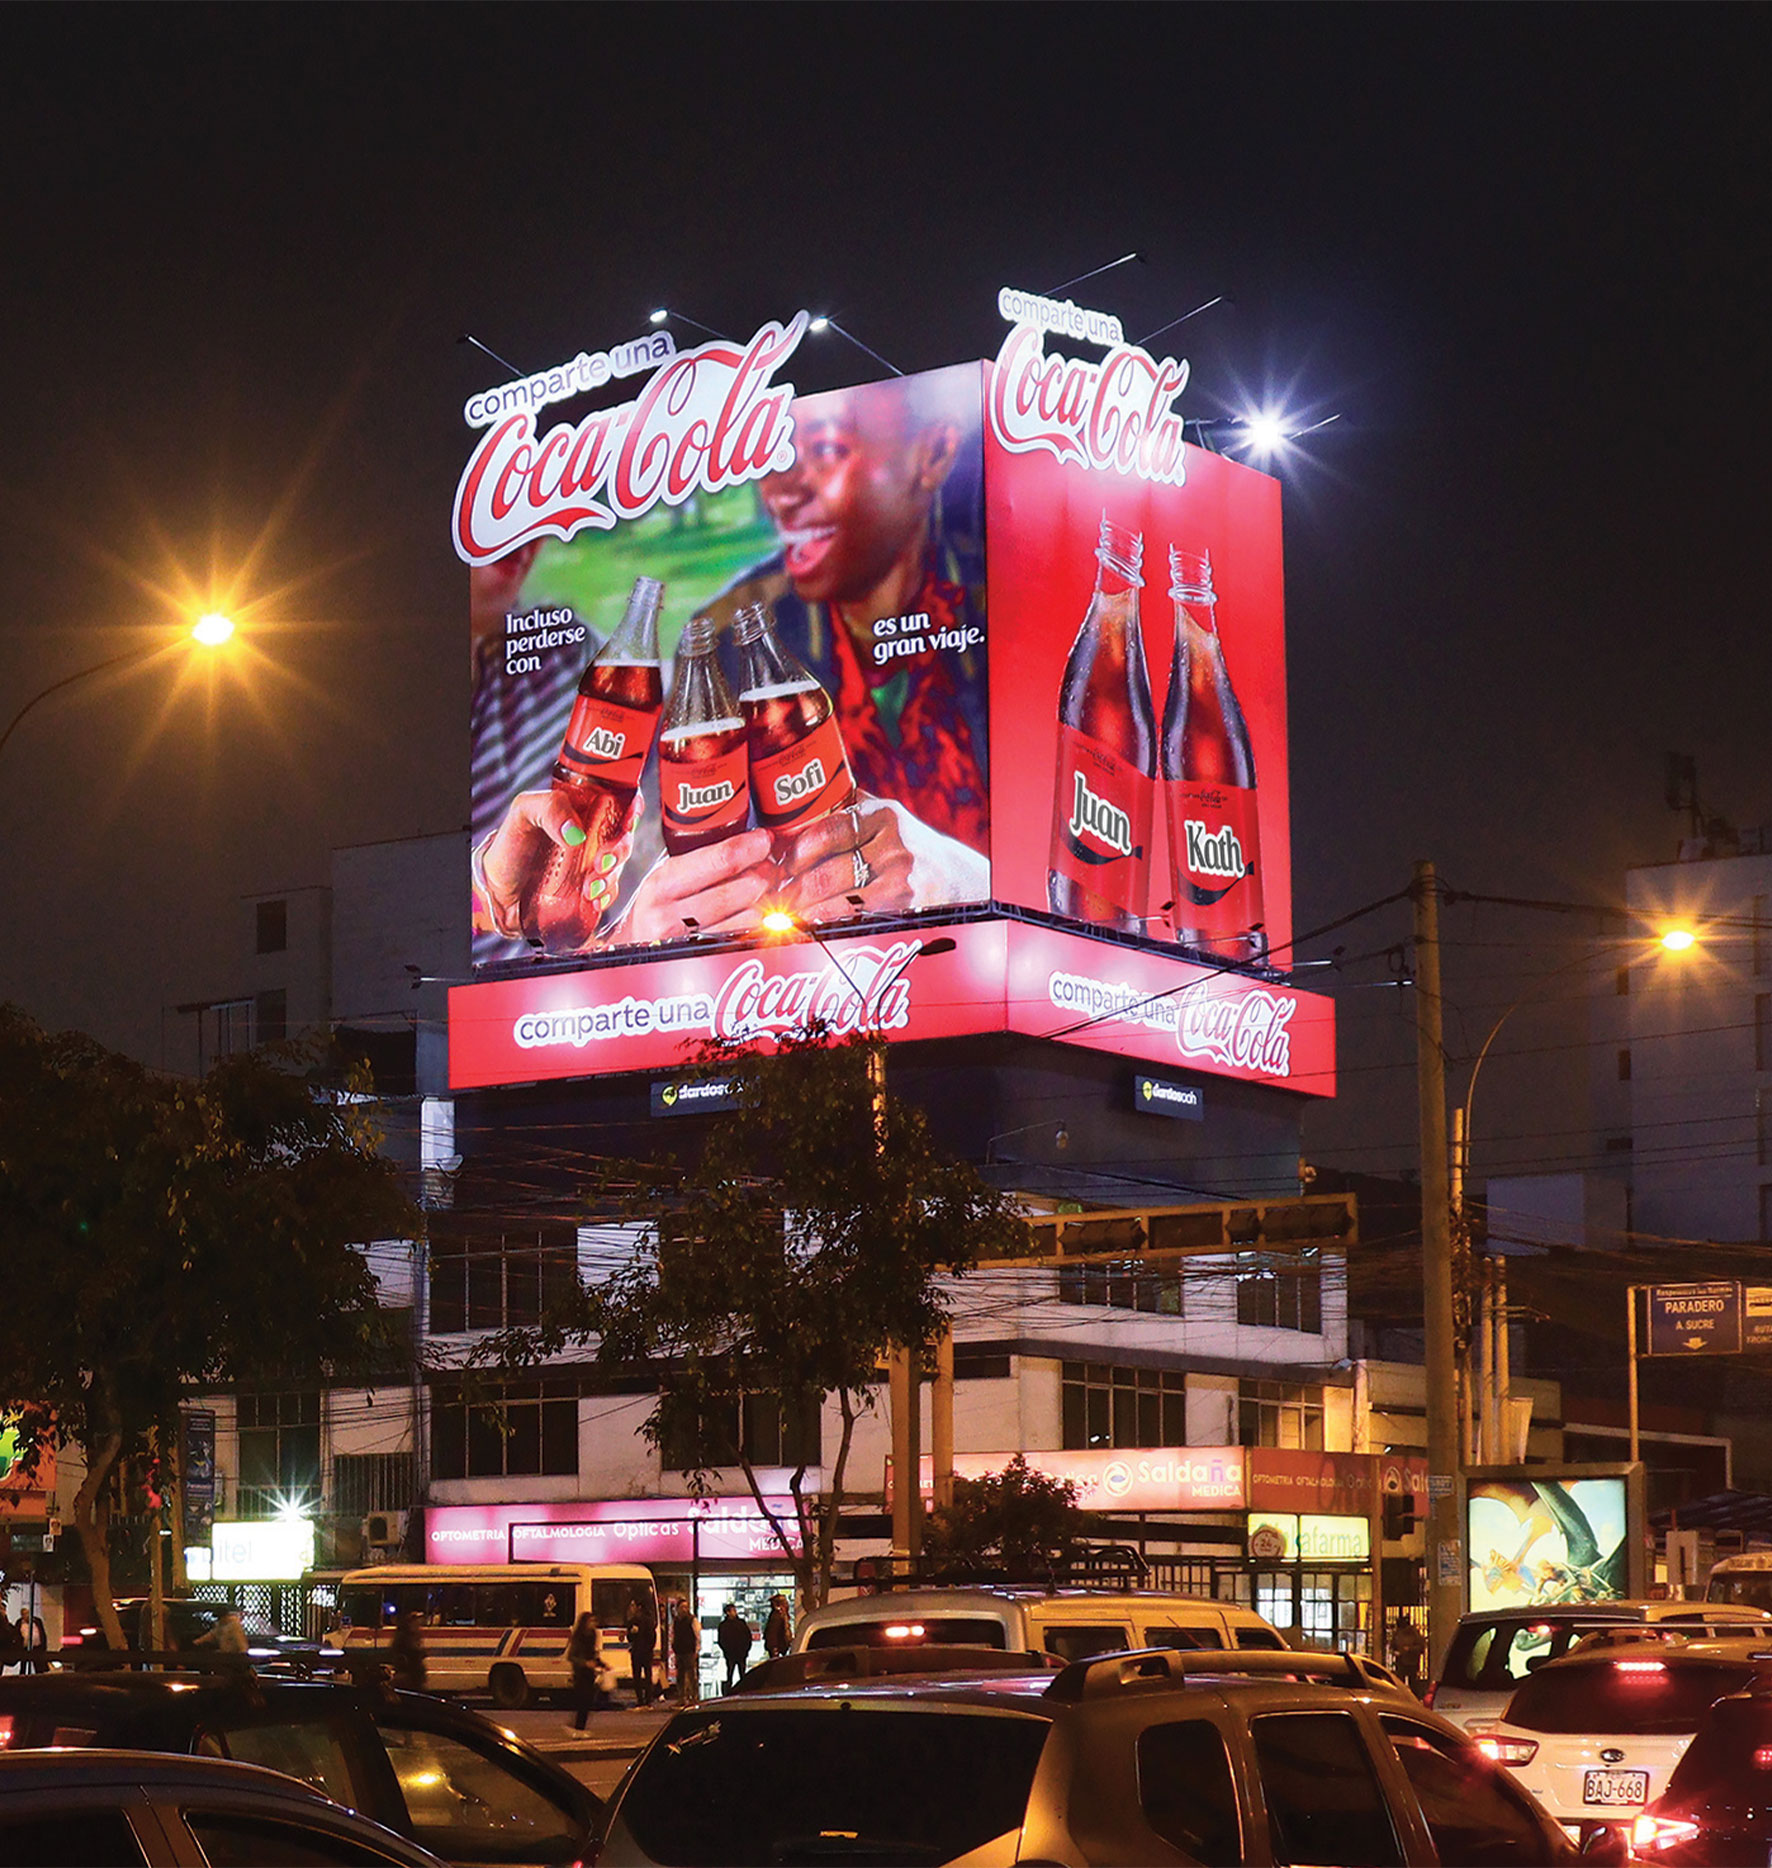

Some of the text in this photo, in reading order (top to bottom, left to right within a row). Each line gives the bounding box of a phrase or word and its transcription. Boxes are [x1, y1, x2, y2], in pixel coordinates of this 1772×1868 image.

[1001, 293, 1121, 342] comparte una
[467, 335, 671, 421] comparte una
[505, 607, 573, 634] Incluso
[873, 612, 931, 637] es un
[505, 626, 586, 660] perderse
[873, 624, 985, 665] gran viaje.
[505, 655, 542, 675] con
[584, 728, 624, 757] Abi
[679, 782, 733, 811] Juan
[775, 761, 824, 803] Sofi
[1071, 774, 1131, 851] Juan
[1186, 823, 1243, 874] Kath
[1052, 978, 1139, 1018] comparte
[1143, 1000, 1177, 1026] una
[519, 1001, 651, 1042] comparte
[658, 999, 711, 1025] una
[1664, 1299, 1725, 1314] PARADERO
[1685, 1318, 1716, 1330] SUCRE
[1137, 1459, 1242, 1484] Saldaña
[1191, 1484, 1242, 1498] MEDICA
[430, 1530, 506, 1542] OPTOMETRIA
[512, 1525, 606, 1540] OFTALMOLOGIA
[1586, 1779, 1643, 1799] BAJ-668
